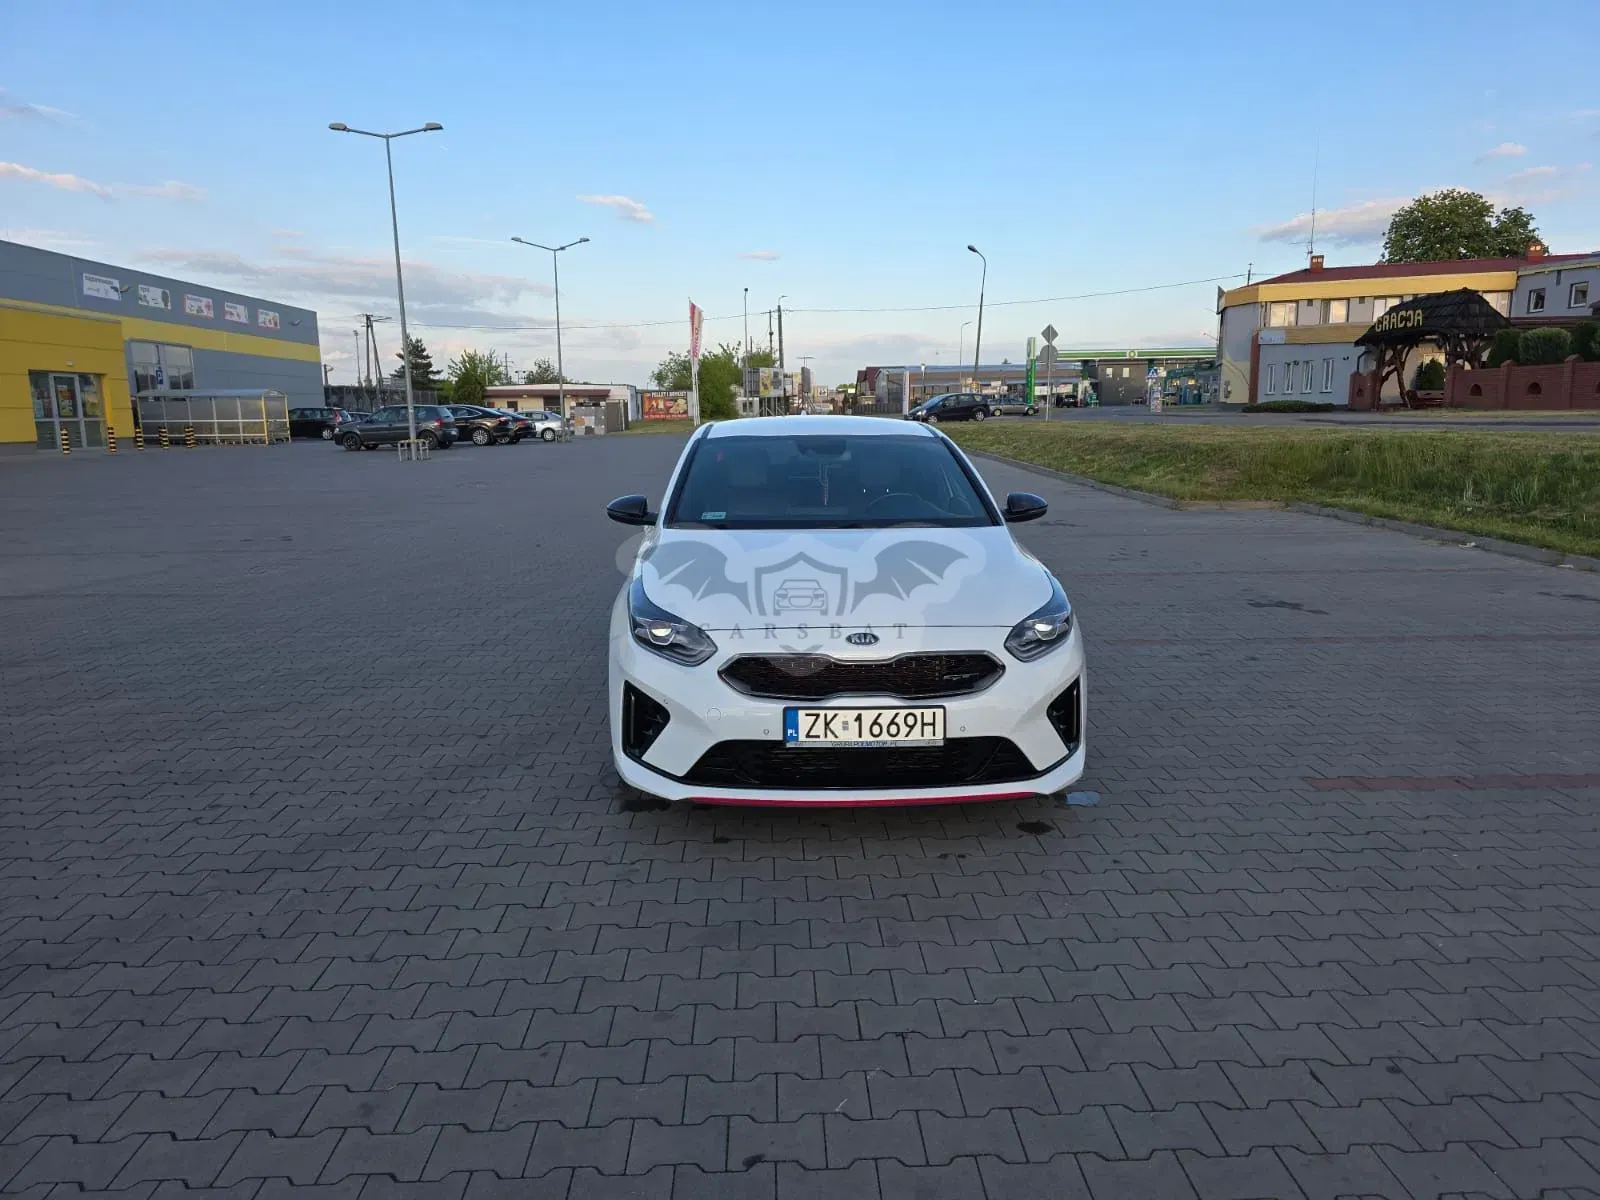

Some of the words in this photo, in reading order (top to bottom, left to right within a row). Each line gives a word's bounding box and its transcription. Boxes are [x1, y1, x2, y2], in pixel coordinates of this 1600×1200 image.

[1375, 309, 1423, 332] GRACJA
[851, 633, 876, 643] KIA
[788, 729, 798, 737] PL
[804, 712, 839, 739] ZK
[853, 711, 937, 739] 1669H
